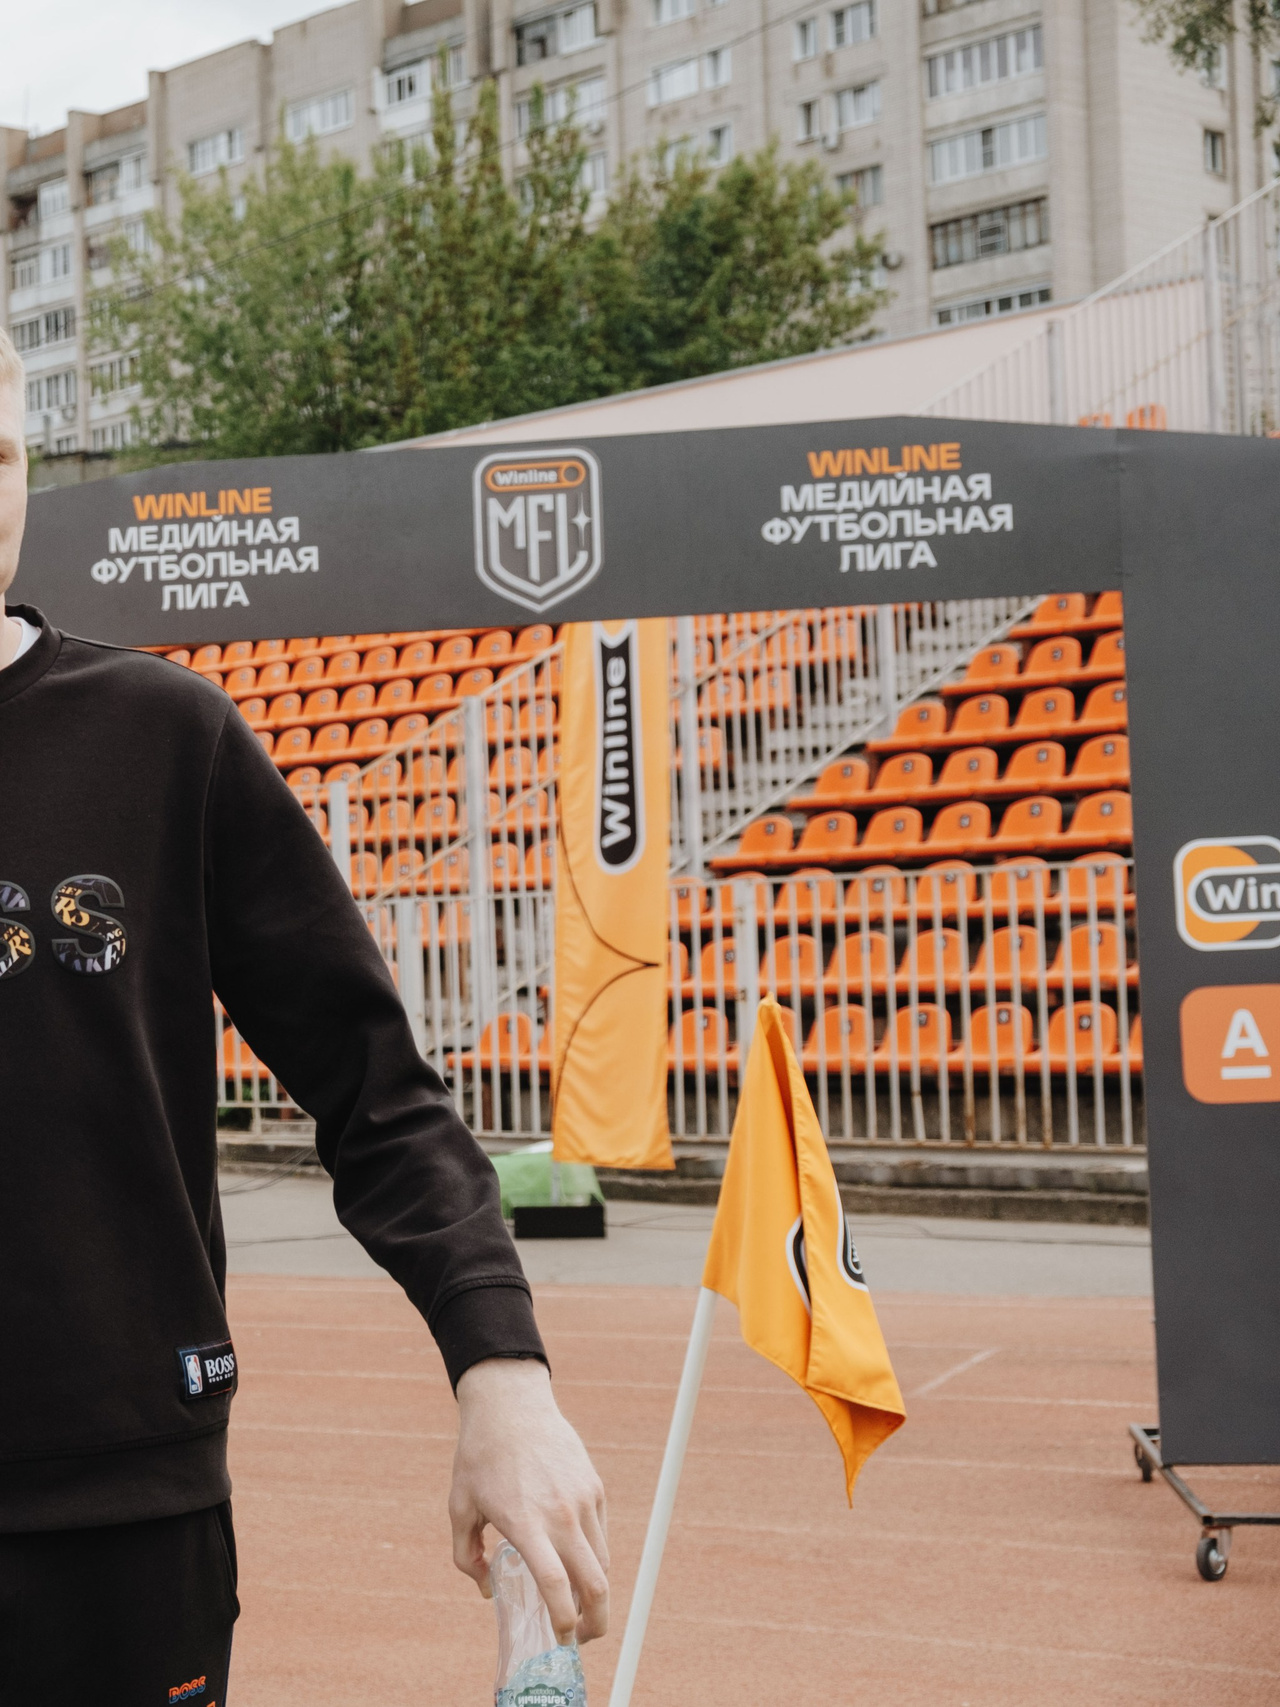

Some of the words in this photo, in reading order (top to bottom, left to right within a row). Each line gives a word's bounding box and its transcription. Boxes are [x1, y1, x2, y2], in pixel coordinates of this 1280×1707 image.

[494, 469, 558, 486] Winline
[807, 442, 962, 479] WINLINE
[133, 487, 273, 521] WINLINE
[780, 471, 992, 513] МЕДИЙНАЯ
[108, 515, 300, 554] МЕДИЙНАЯ
[761, 503, 1014, 545] ФУТБОЛЬНАЯ
[487, 493, 588, 597] MFL
[840, 540, 938, 573] ЛИГА
[90, 545, 320, 584] ФУТБОЛЬНАЯ
[161, 581, 250, 611] ЛИГА
[602, 656, 632, 849] Winline
[204, 1353, 235, 1378] BOSS
